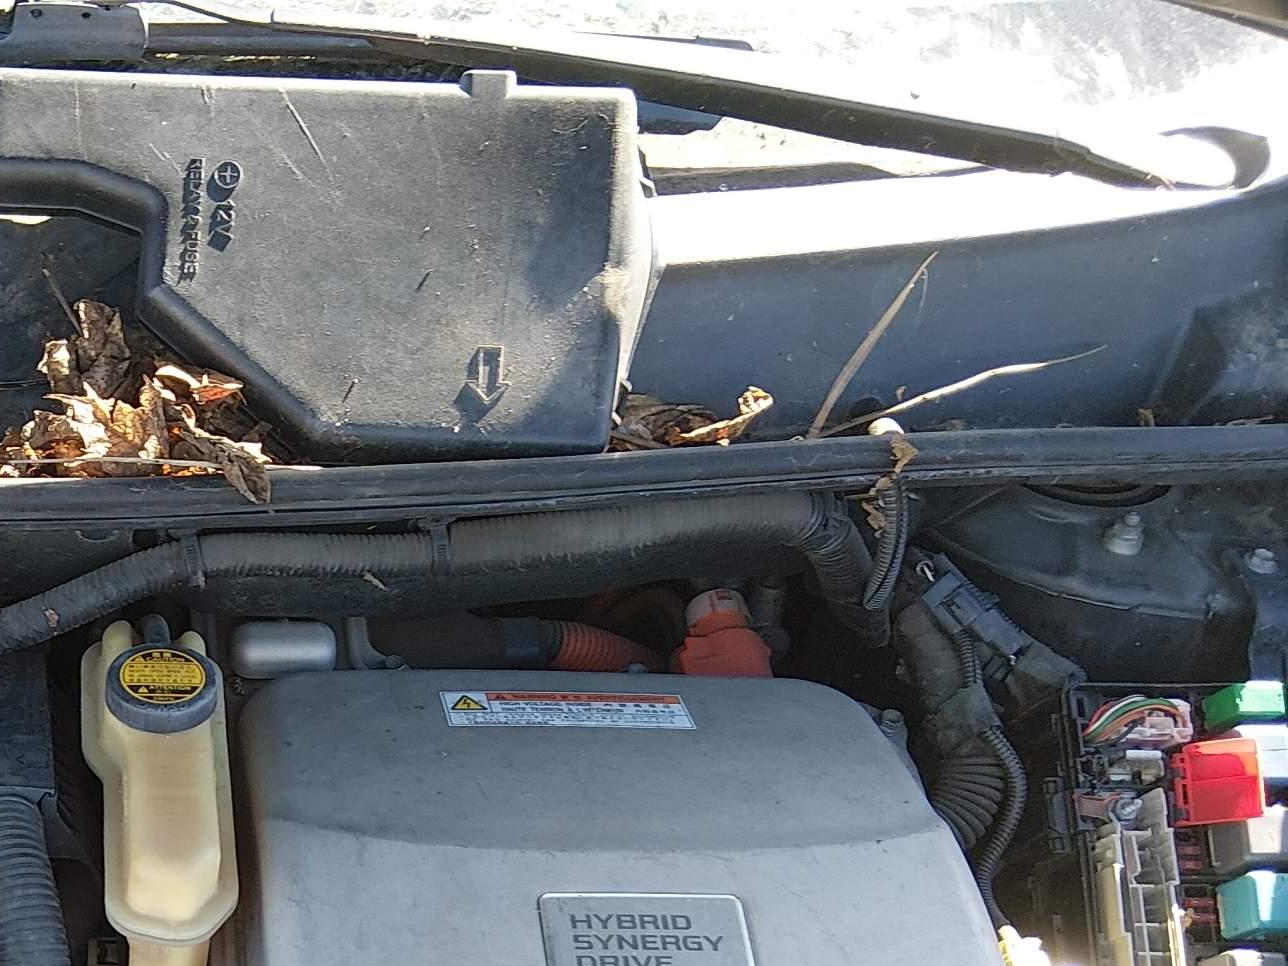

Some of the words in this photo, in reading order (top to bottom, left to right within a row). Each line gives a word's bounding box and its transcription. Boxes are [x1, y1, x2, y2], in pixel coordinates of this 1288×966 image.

[188, 157, 206, 211] RELAY
[209, 199, 237, 240] 12V
[184, 230, 202, 274] FUSE
[569, 913, 692, 930] HYBRID
[572, 935, 724, 952] SYNERGY
